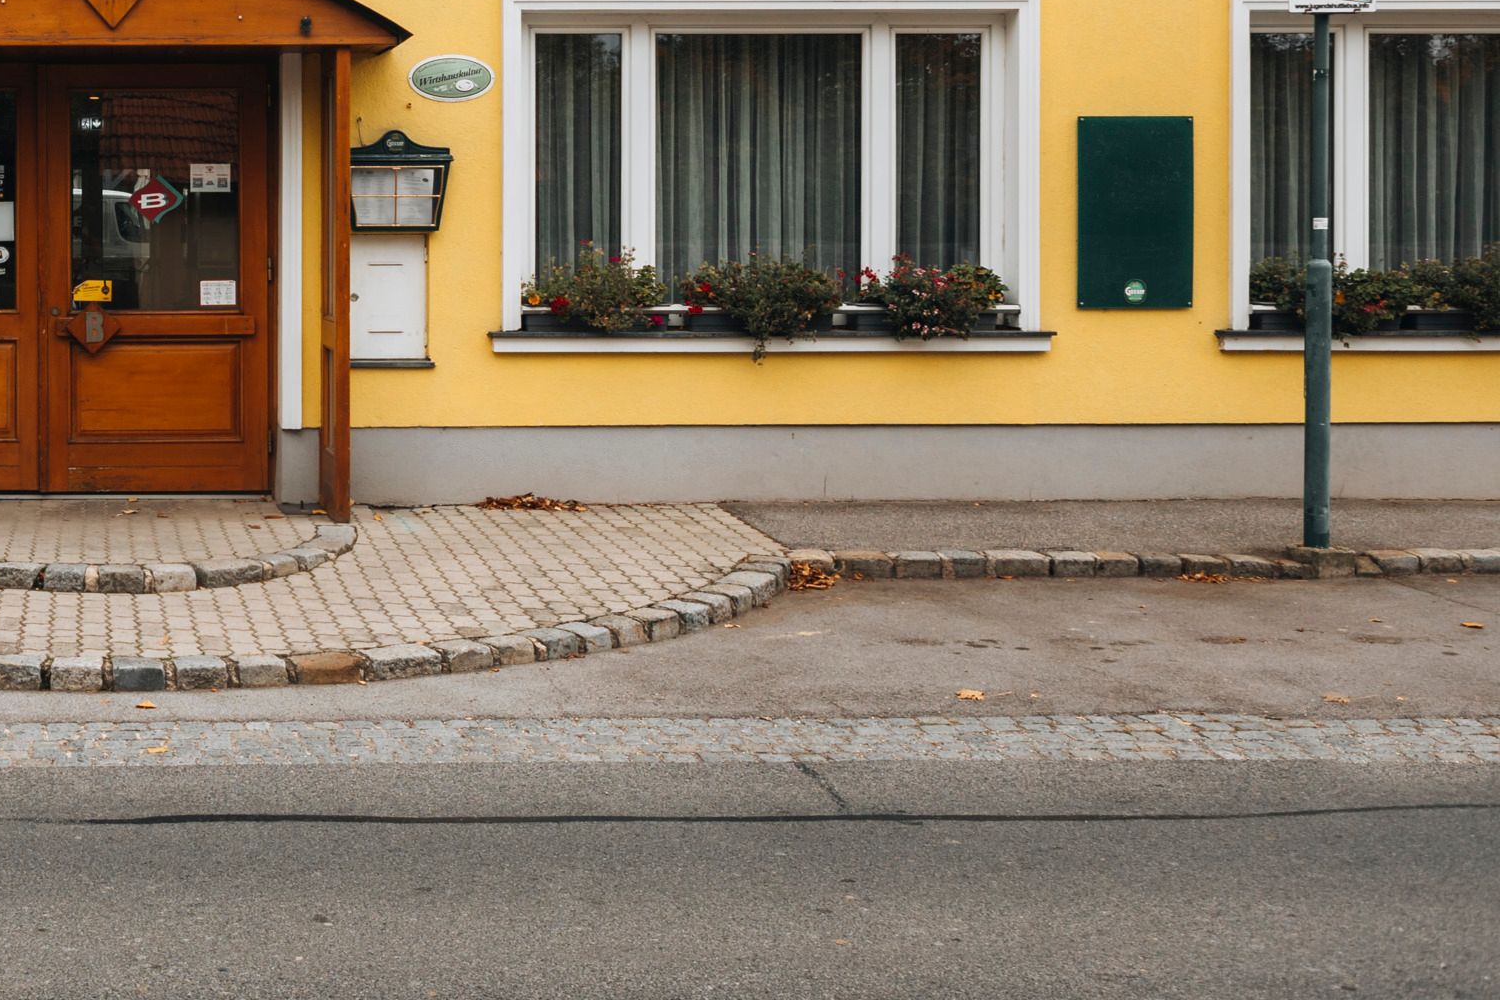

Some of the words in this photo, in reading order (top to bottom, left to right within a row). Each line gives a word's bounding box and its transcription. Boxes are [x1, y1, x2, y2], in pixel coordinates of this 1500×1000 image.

[419, 67, 483, 86] Wirtshauskultur
[137, 193, 167, 209] B
[86, 312, 104, 343] B
